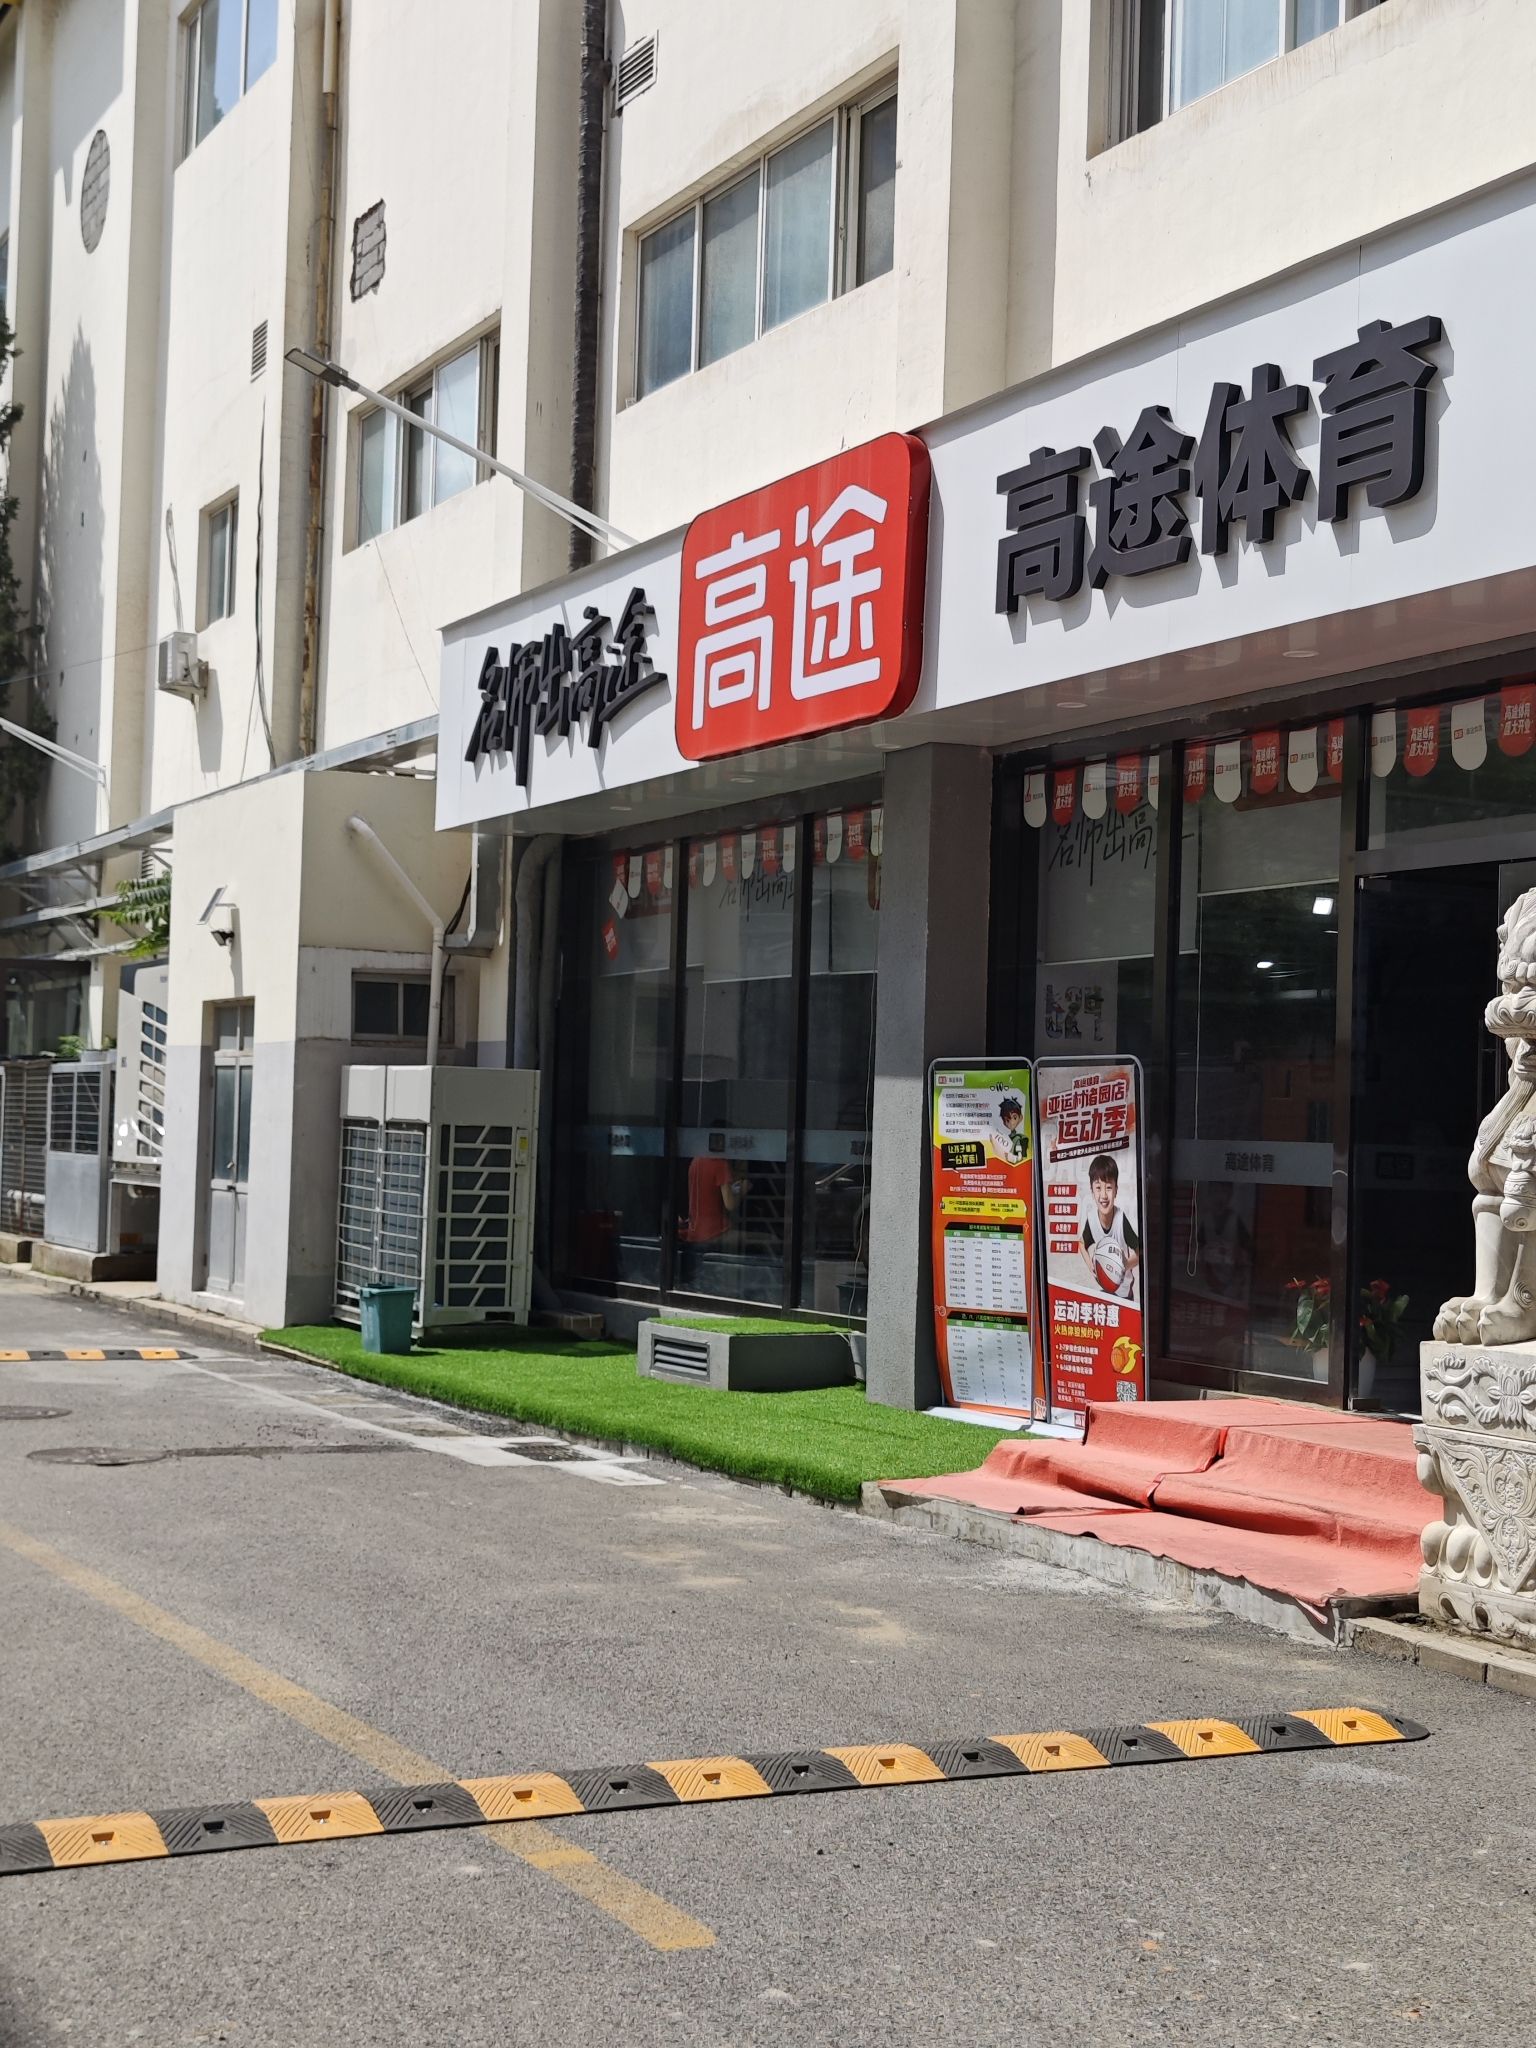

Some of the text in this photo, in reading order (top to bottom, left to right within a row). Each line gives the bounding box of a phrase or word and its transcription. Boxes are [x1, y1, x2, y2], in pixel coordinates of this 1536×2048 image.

[995, 315, 1442, 614] 高途体育
[692, 484, 888, 731] 高途
[464, 587, 668, 787] 名师出高途
[1057, 1104, 1127, 1145] 运动季
[1225, 1152, 1275, 1173] 高途体育
[1053, 1299, 1120, 1328] 运动季特惠
